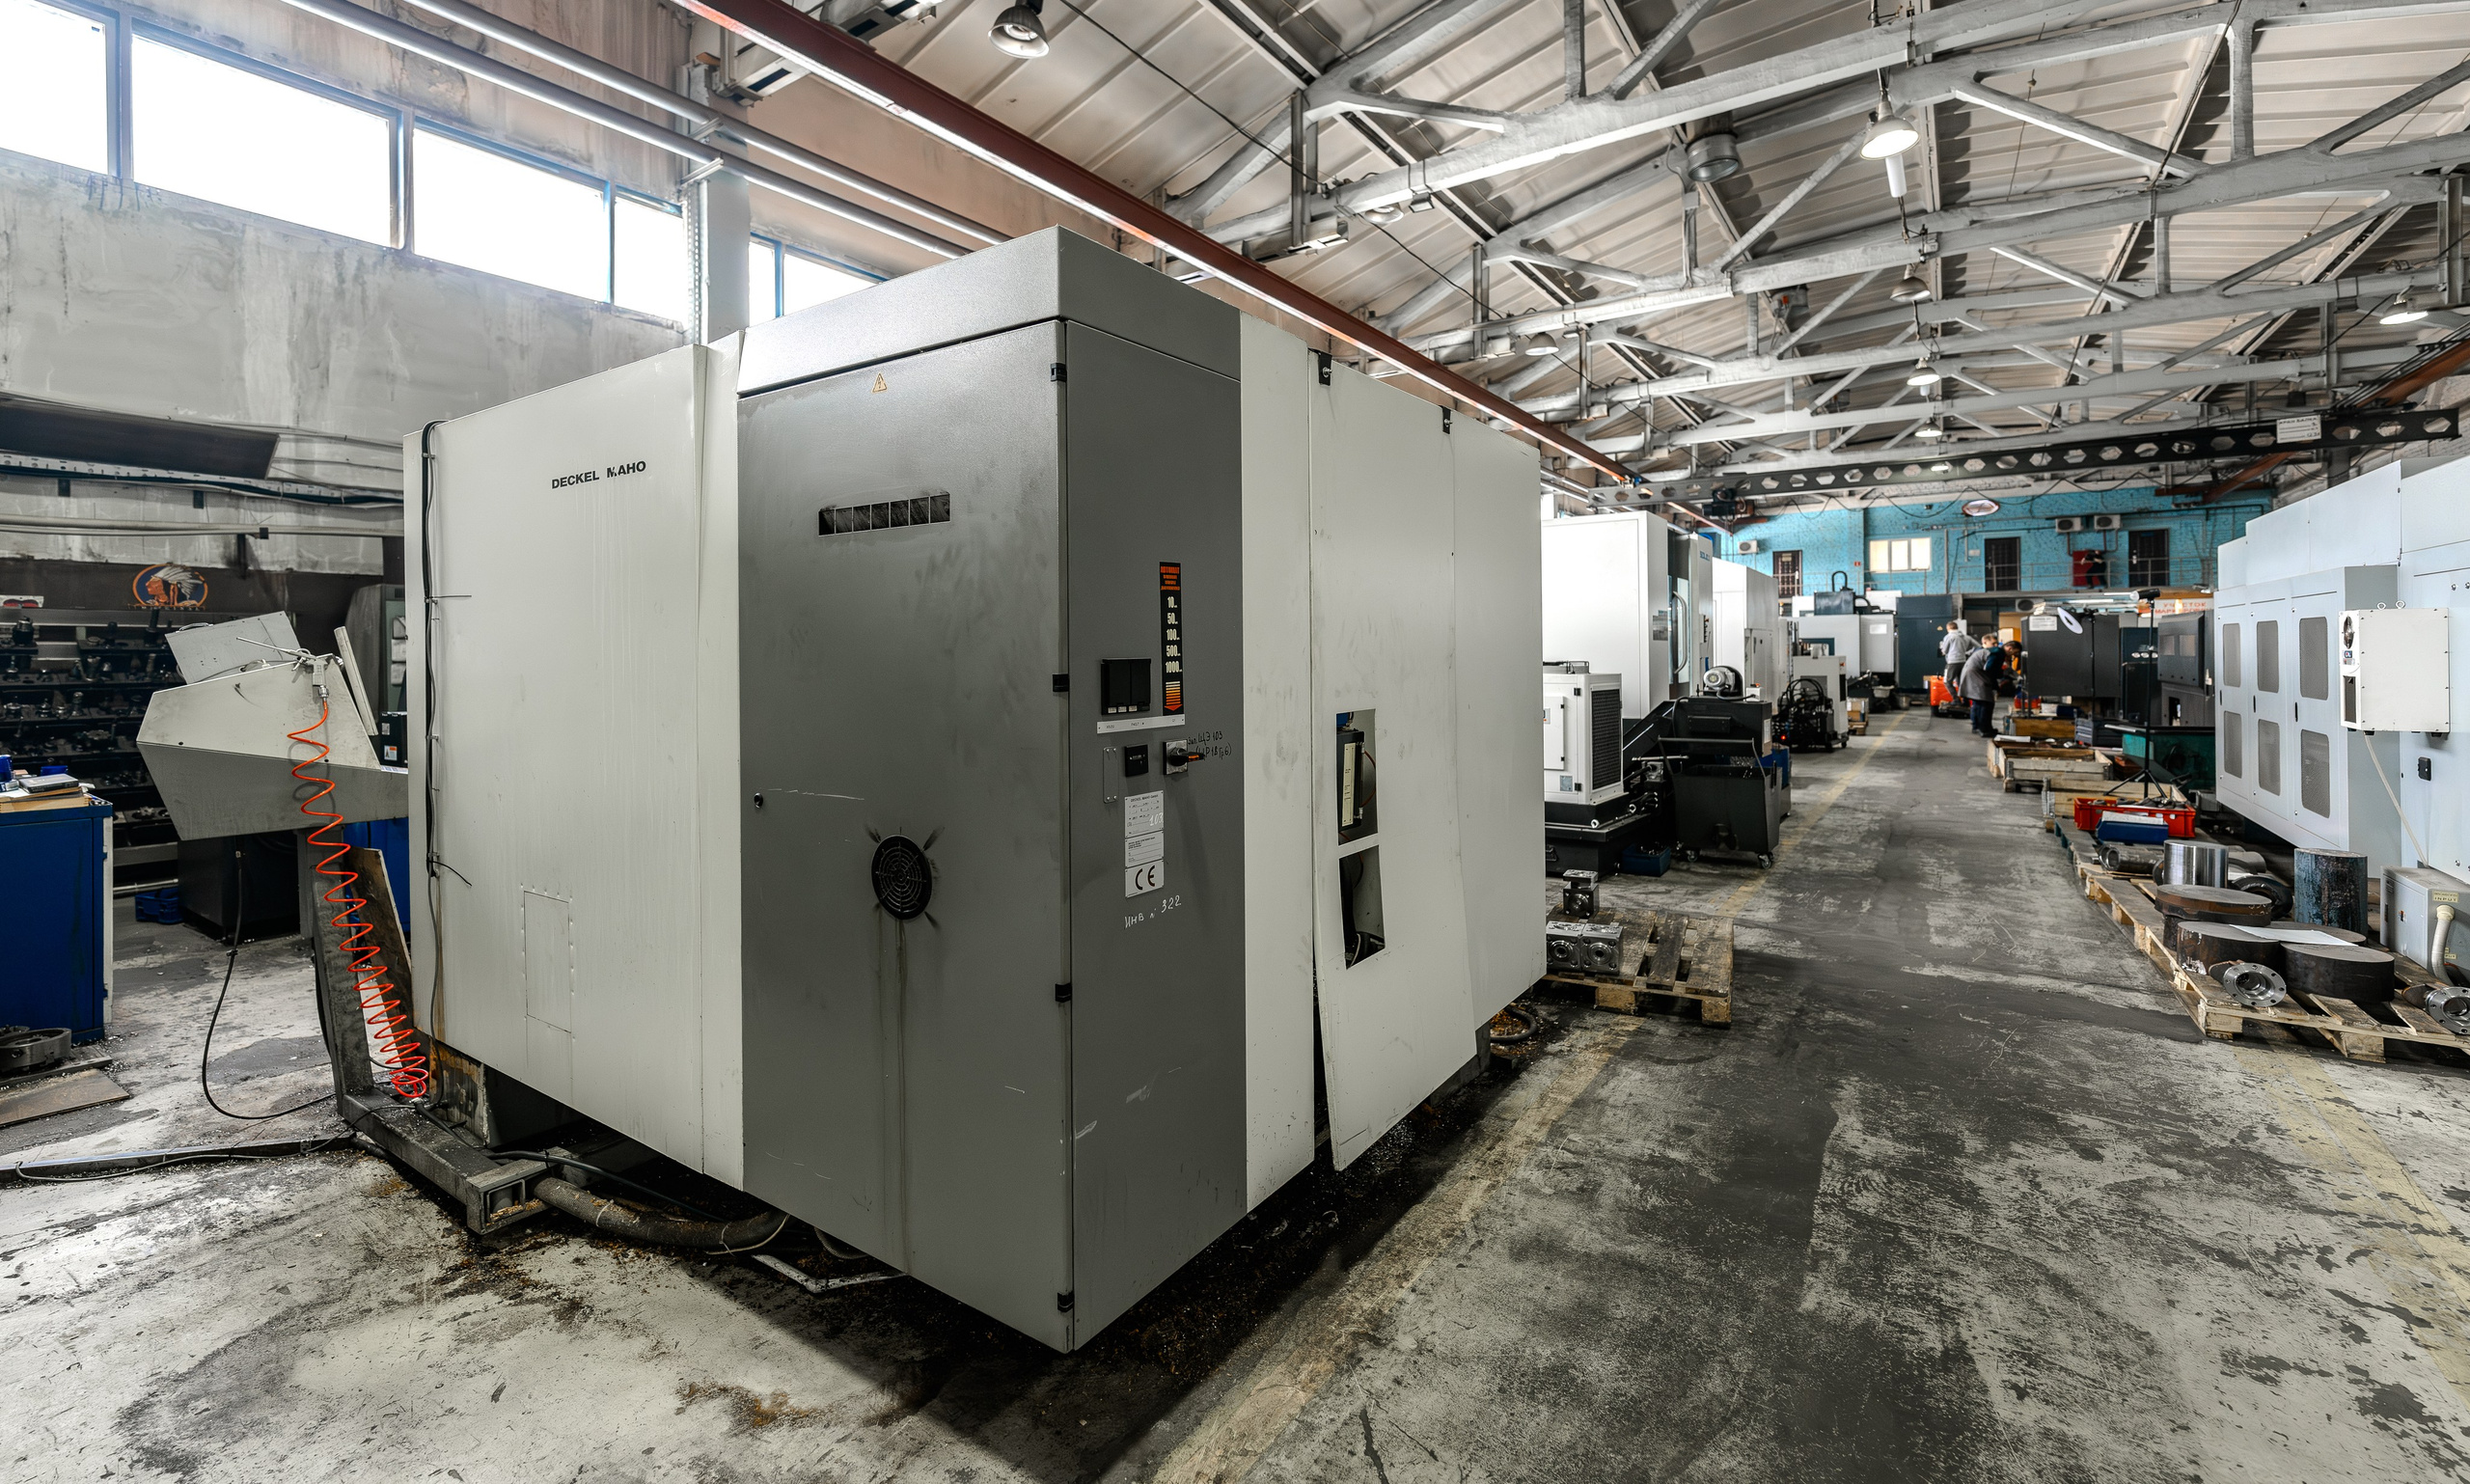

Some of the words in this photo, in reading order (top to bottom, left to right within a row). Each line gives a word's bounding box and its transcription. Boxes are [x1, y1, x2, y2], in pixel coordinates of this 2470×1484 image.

[552, 470, 600, 489] DECKEL
[1213, 730, 1223, 741] 103
[1149, 811, 1164, 827] 103
[1135, 865, 1156, 891] CE
[1161, 894, 1182, 913] 322
